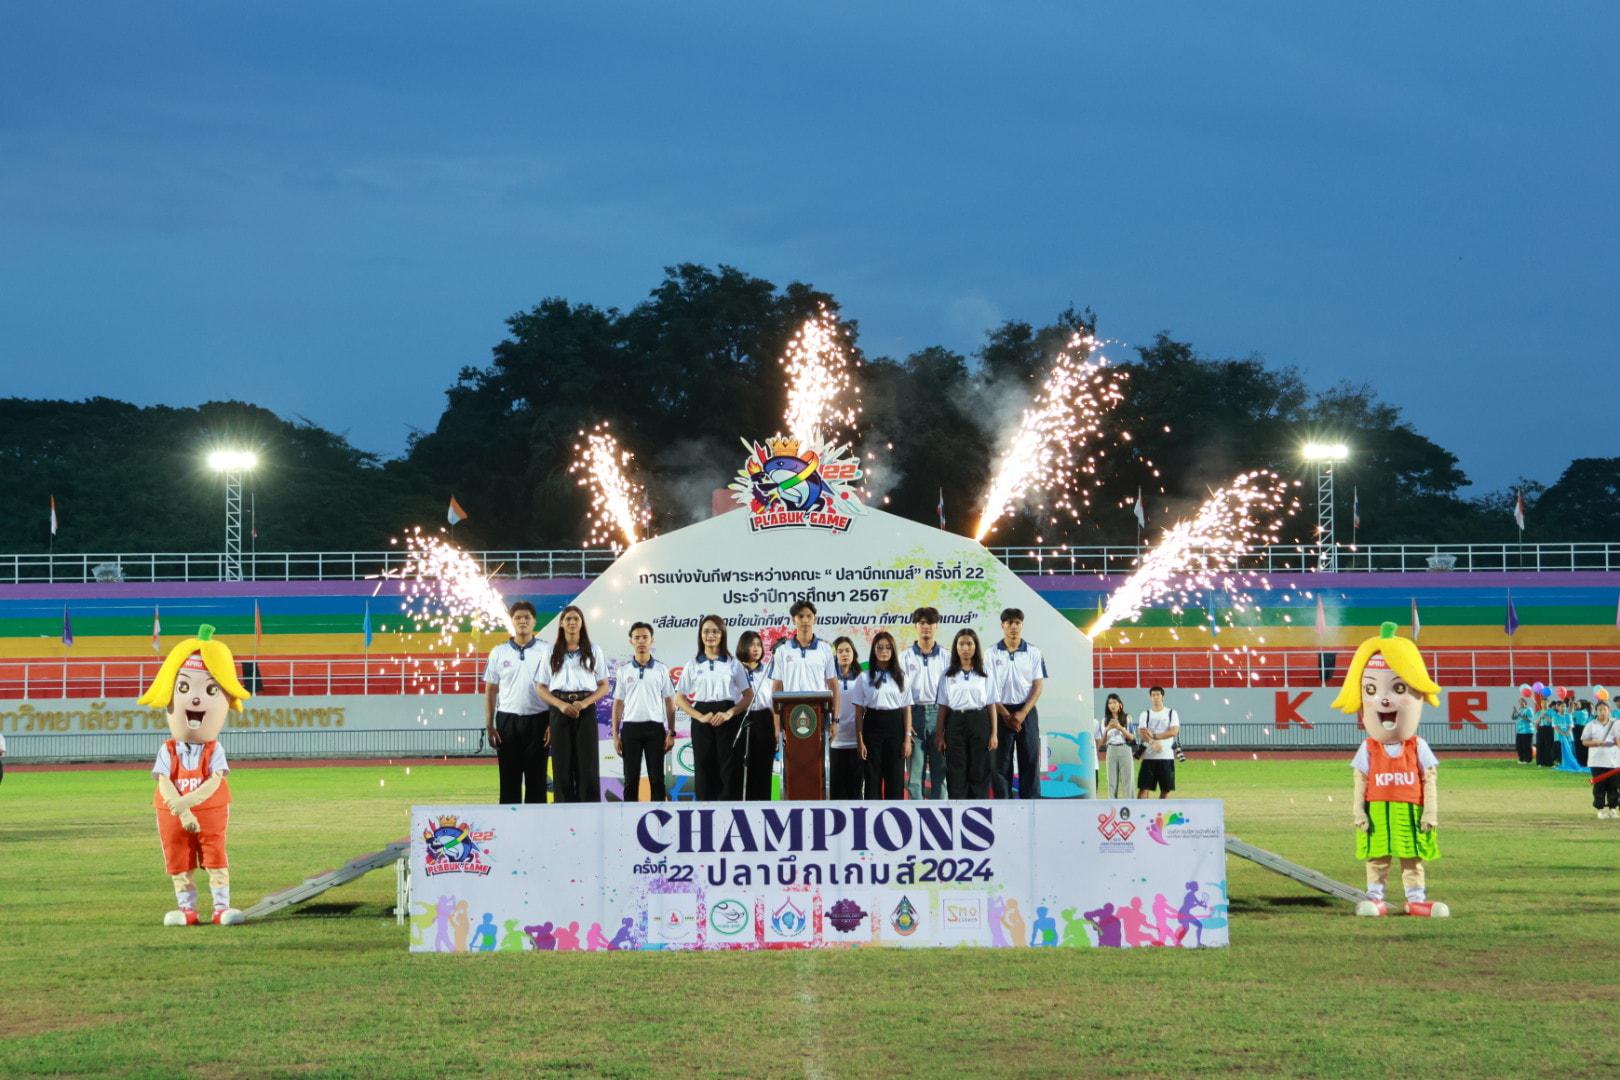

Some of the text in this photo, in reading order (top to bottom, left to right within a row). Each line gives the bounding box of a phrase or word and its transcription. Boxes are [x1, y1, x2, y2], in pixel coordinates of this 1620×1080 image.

[754, 511, 848, 528] PLABUK GAME
[639, 567, 821, 585] การแข่งขันกีฬาระหว่างคณะ
[925, 562, 961, 580] ครั้งที่
[965, 567, 984, 580] 22
[723, 586, 888, 604] ประจำปีการศึกษา 2567
[1375, 771, 1415, 787] KPRU
[636, 806, 995, 854] CHAMPIONS
[428, 863, 489, 873] PLABUK GAME
[633, 854, 994, 886] ครั้งที่ 22 ปลาบึกเกมส์ 2024
